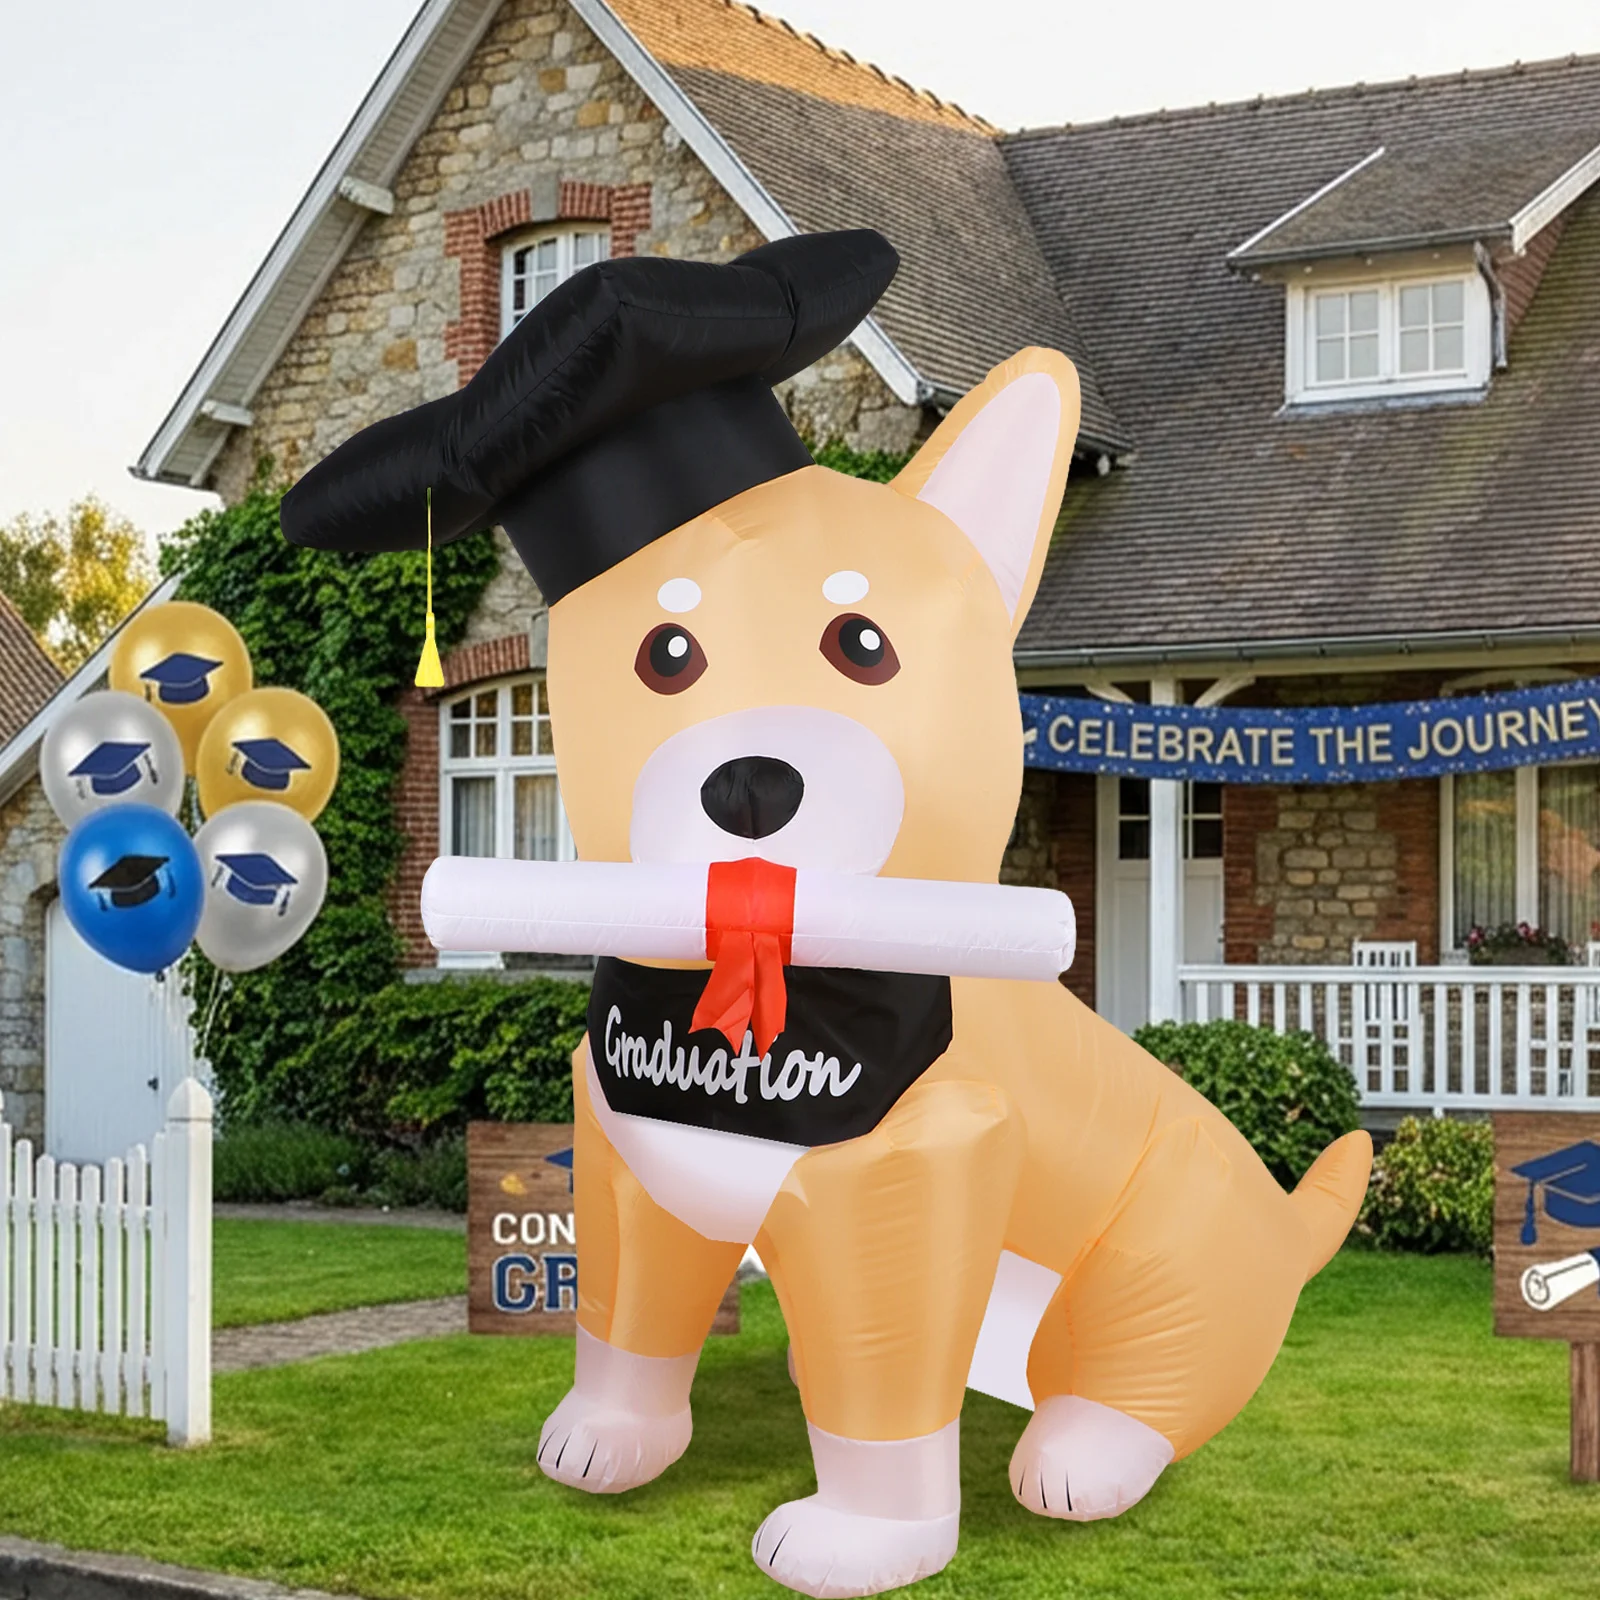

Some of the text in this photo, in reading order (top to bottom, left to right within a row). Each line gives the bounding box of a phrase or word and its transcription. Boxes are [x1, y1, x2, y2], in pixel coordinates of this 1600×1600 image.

[1048, 714, 1295, 766] CELEBRATE
[1308, 723, 1394, 766] THE
[604, 1004, 863, 1104] Graduation
